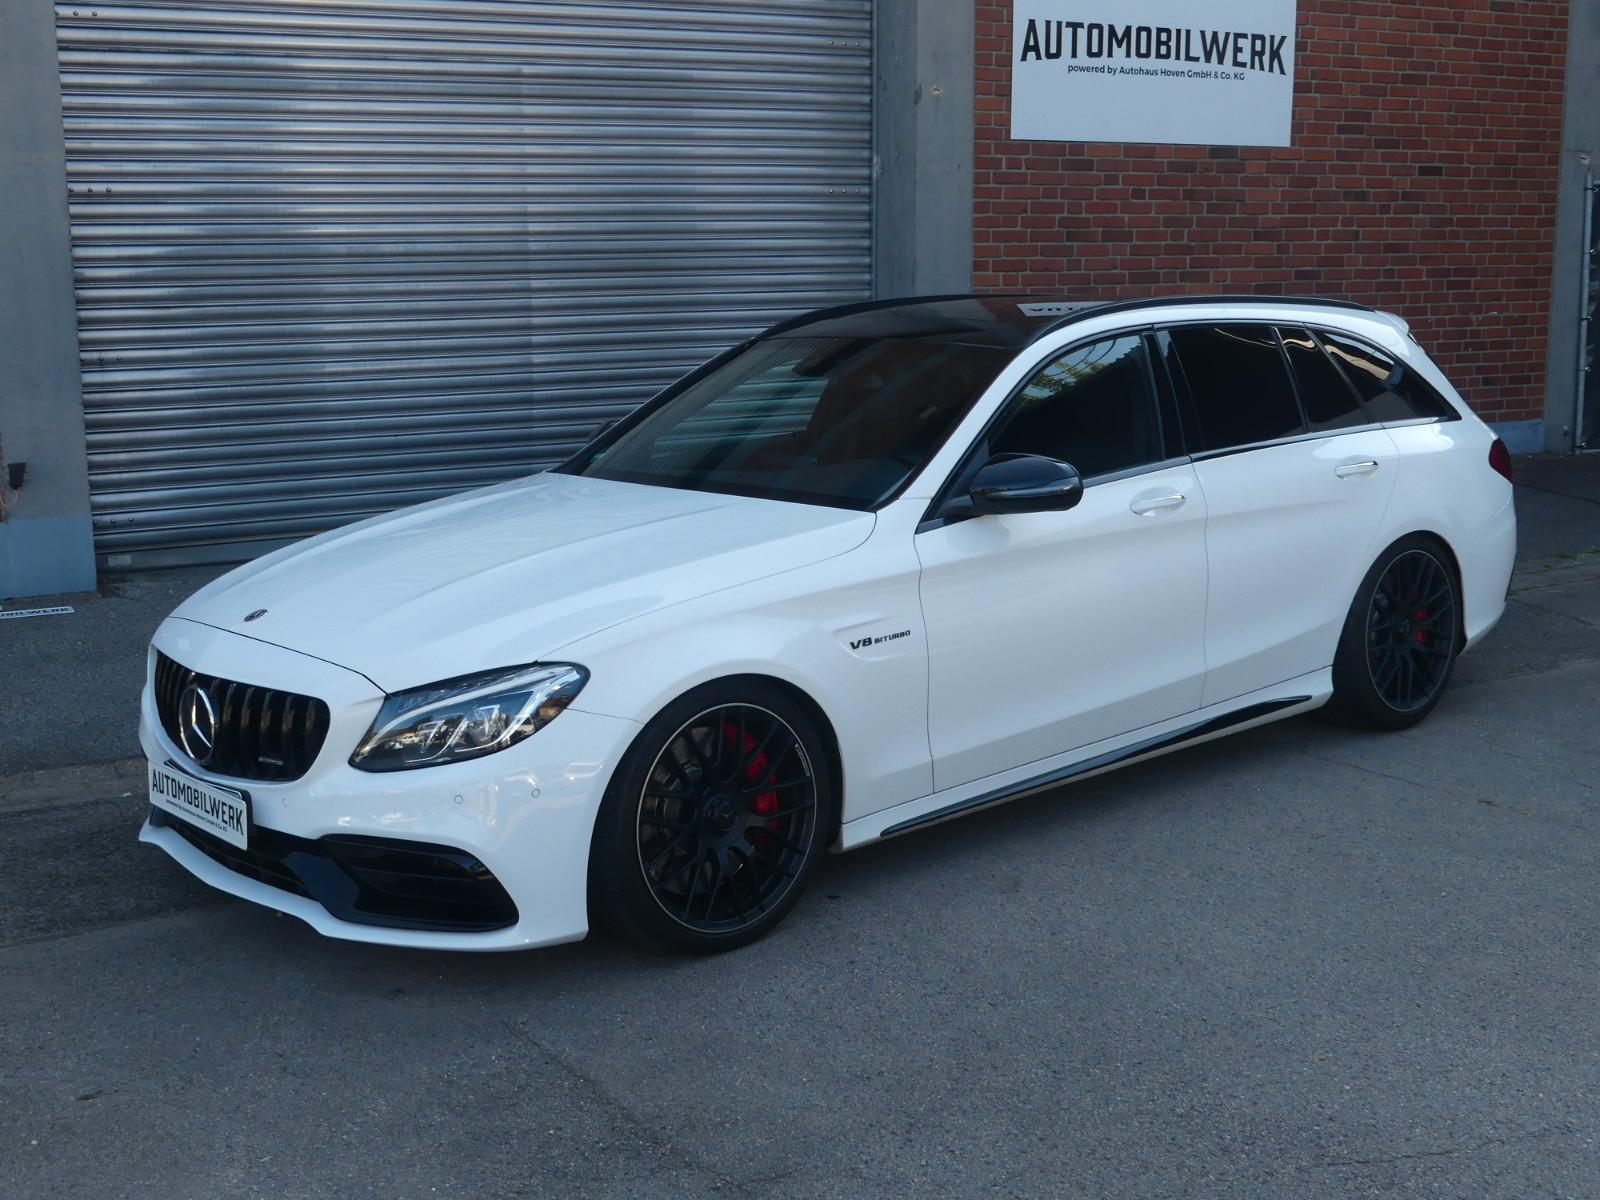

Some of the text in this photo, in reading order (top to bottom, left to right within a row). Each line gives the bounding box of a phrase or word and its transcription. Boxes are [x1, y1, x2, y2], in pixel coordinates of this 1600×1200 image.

[1020, 18, 1288, 76] AUTOMOBILWERK
[1067, 64, 1245, 81] powered by Autohaus Hoven GmbH & Co. KG
[850, 629, 911, 650] V8 BITURBO
[152, 769, 244, 836] AUTOMOBILWERK
